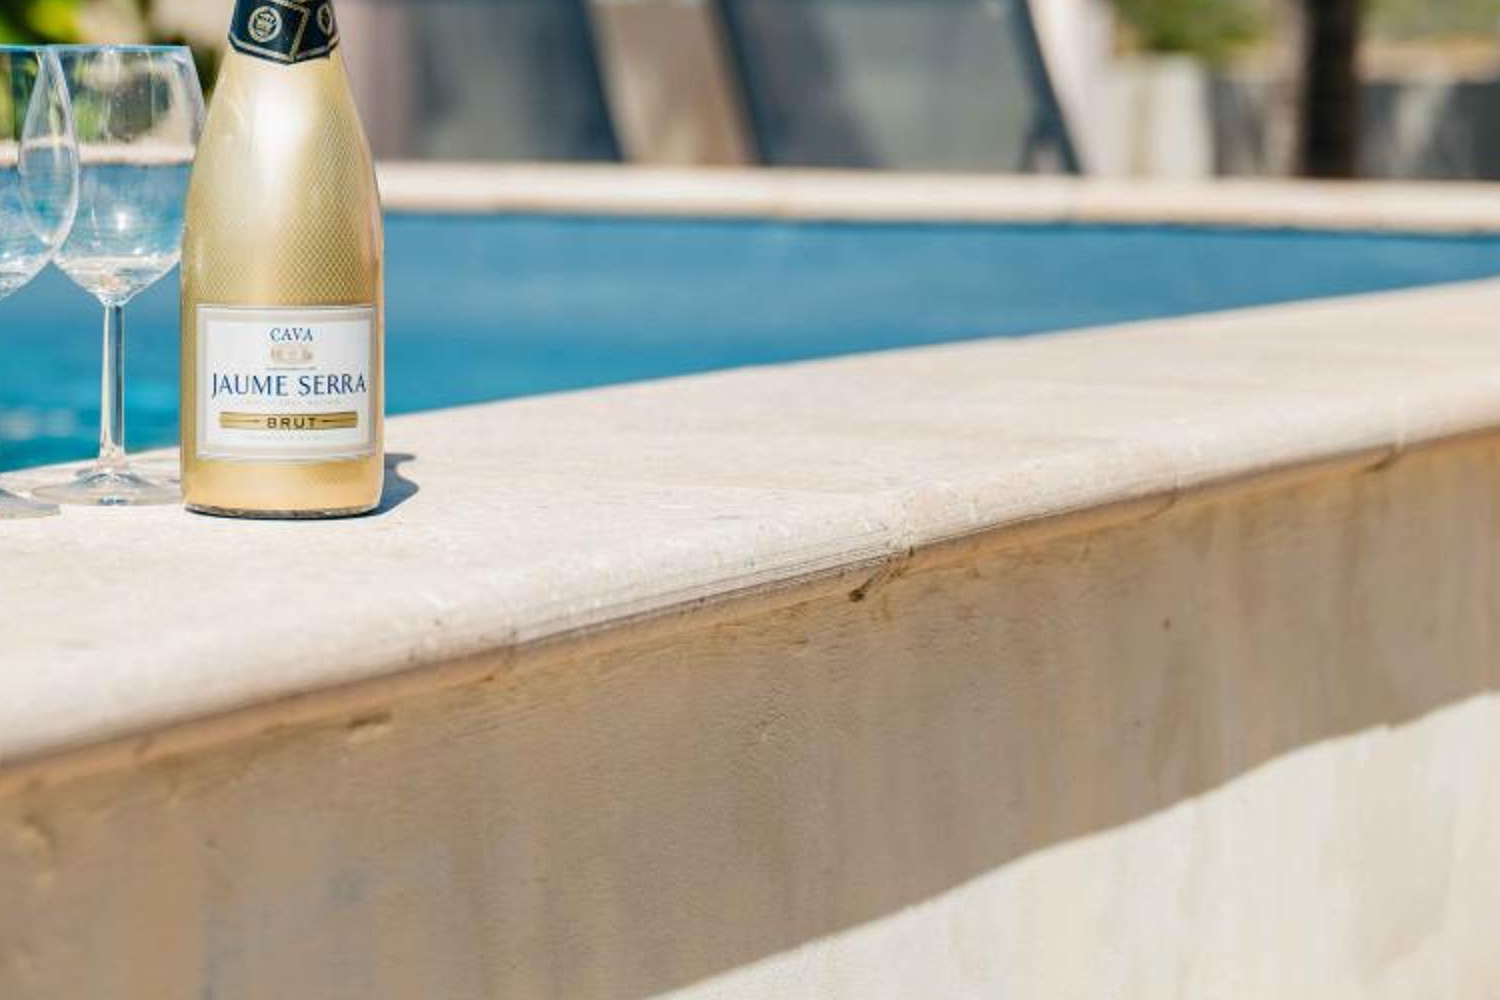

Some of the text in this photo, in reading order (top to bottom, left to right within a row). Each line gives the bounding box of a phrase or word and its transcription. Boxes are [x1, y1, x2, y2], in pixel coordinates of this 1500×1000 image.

[269, 327, 314, 342] CAVA
[212, 373, 367, 398] JAUME SERRA
[266, 417, 318, 430] BRUT
